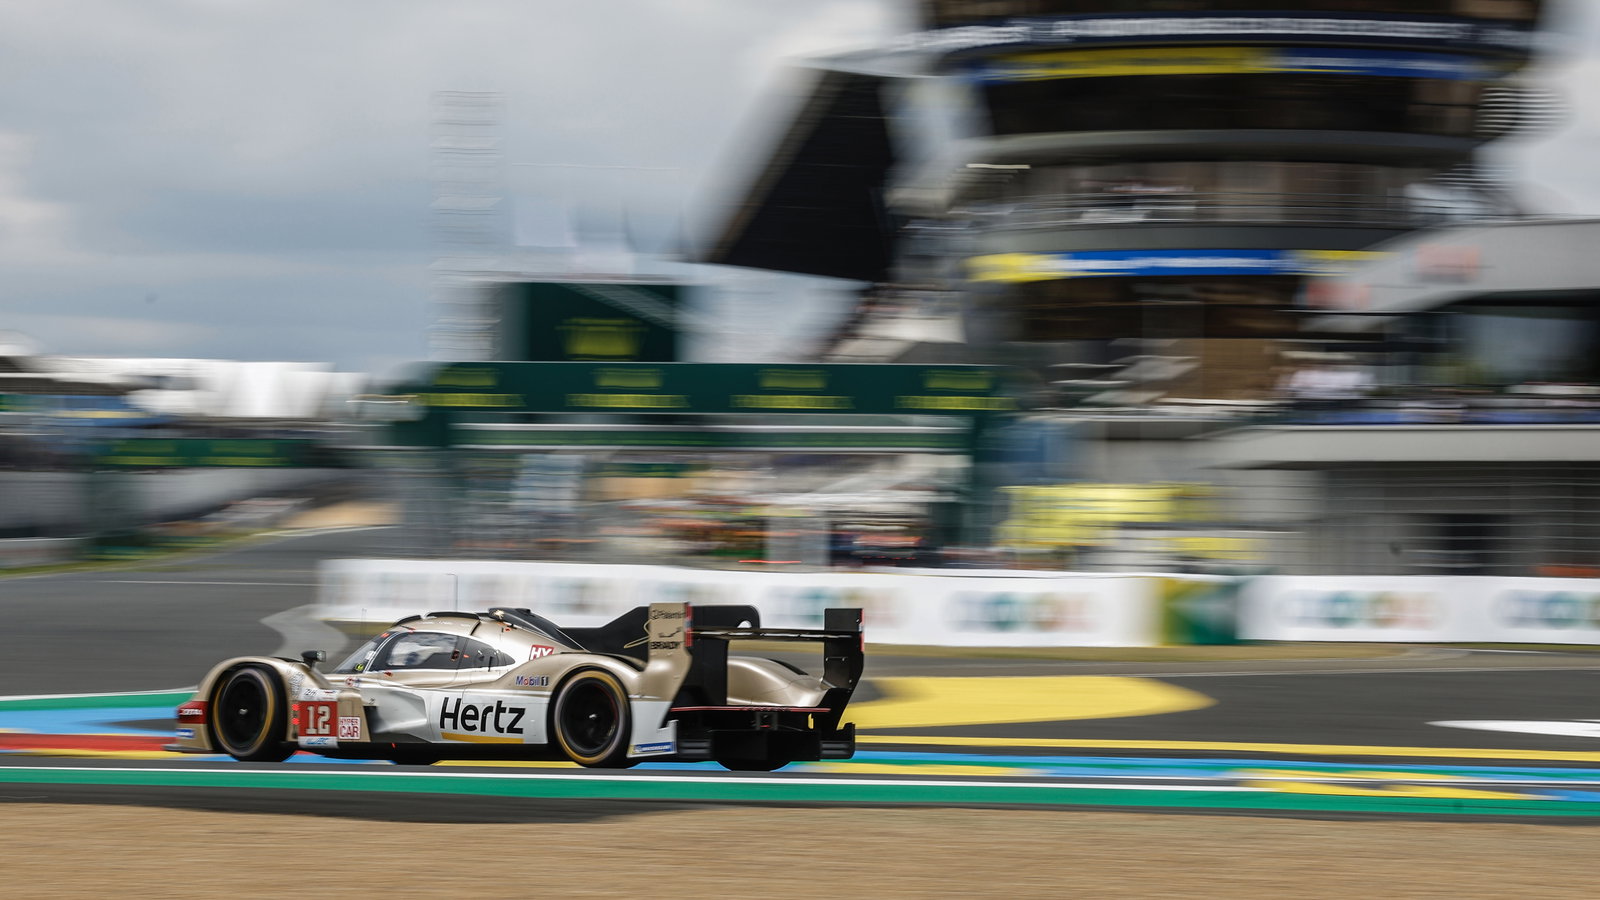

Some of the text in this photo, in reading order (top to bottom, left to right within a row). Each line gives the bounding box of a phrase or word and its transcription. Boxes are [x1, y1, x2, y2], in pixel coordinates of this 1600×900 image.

[516, 675, 540, 686] Mobil
[305, 705, 331, 735] 12
[440, 697, 526, 734] Hertz
[340, 725, 359, 738] CAR
